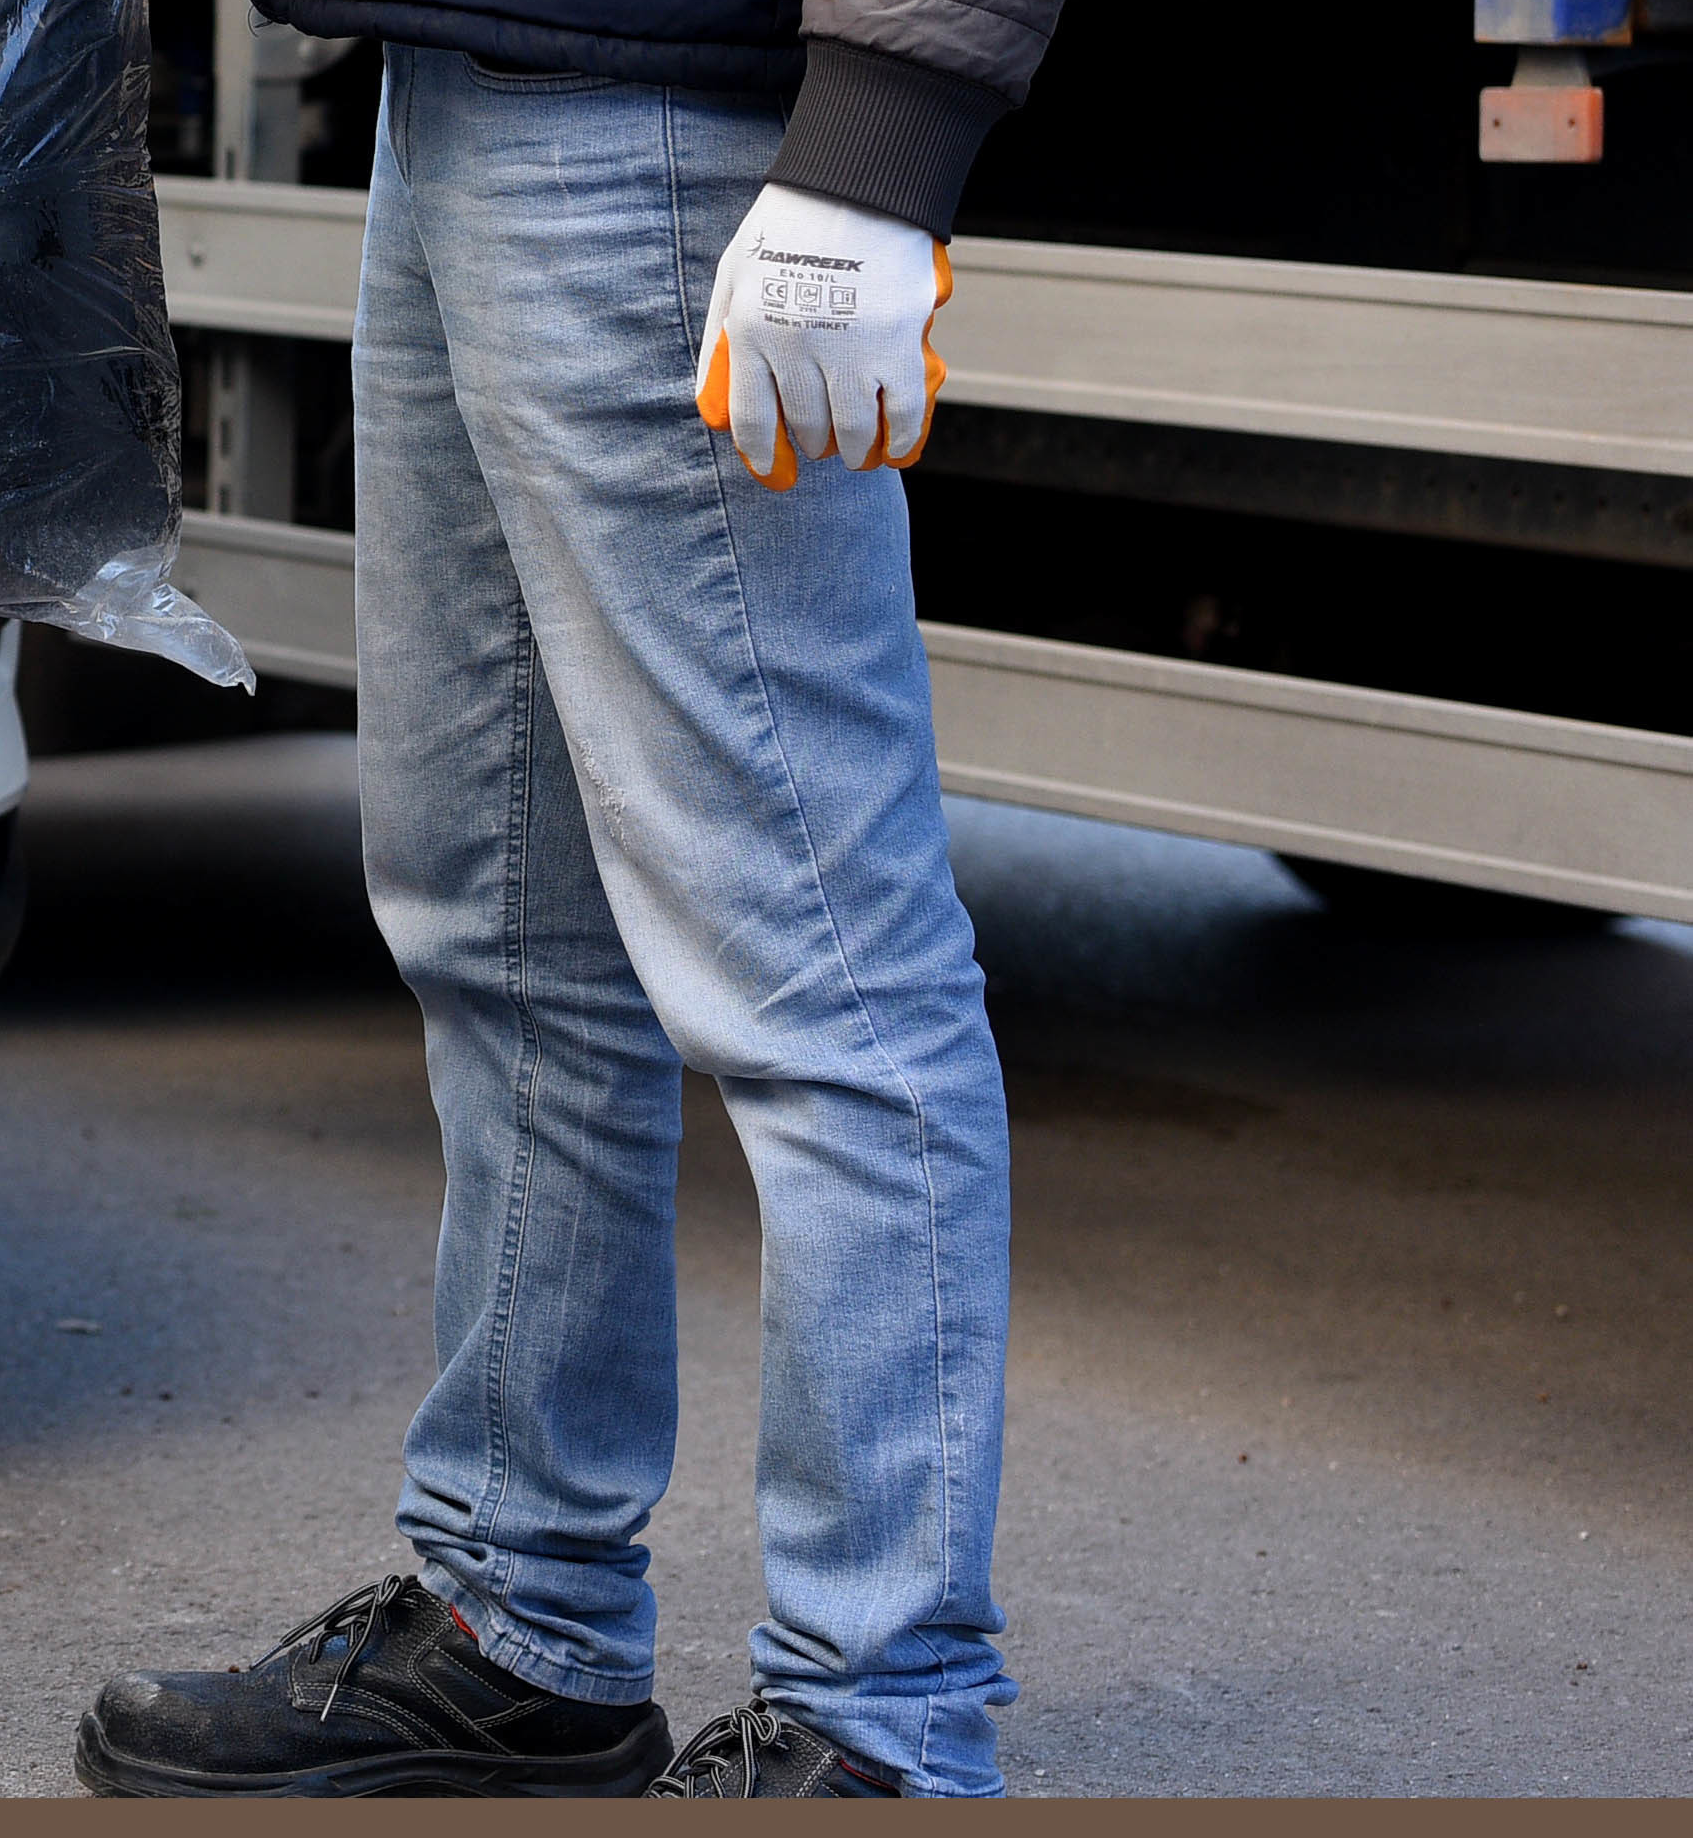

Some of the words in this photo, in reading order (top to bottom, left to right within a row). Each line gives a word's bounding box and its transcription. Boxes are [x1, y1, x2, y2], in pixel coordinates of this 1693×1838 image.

[759, 248, 865, 273] DAWREEK
[764, 313, 789, 327] Made
[792, 318, 801, 328] in
[805, 319, 849, 331] TURKEY
